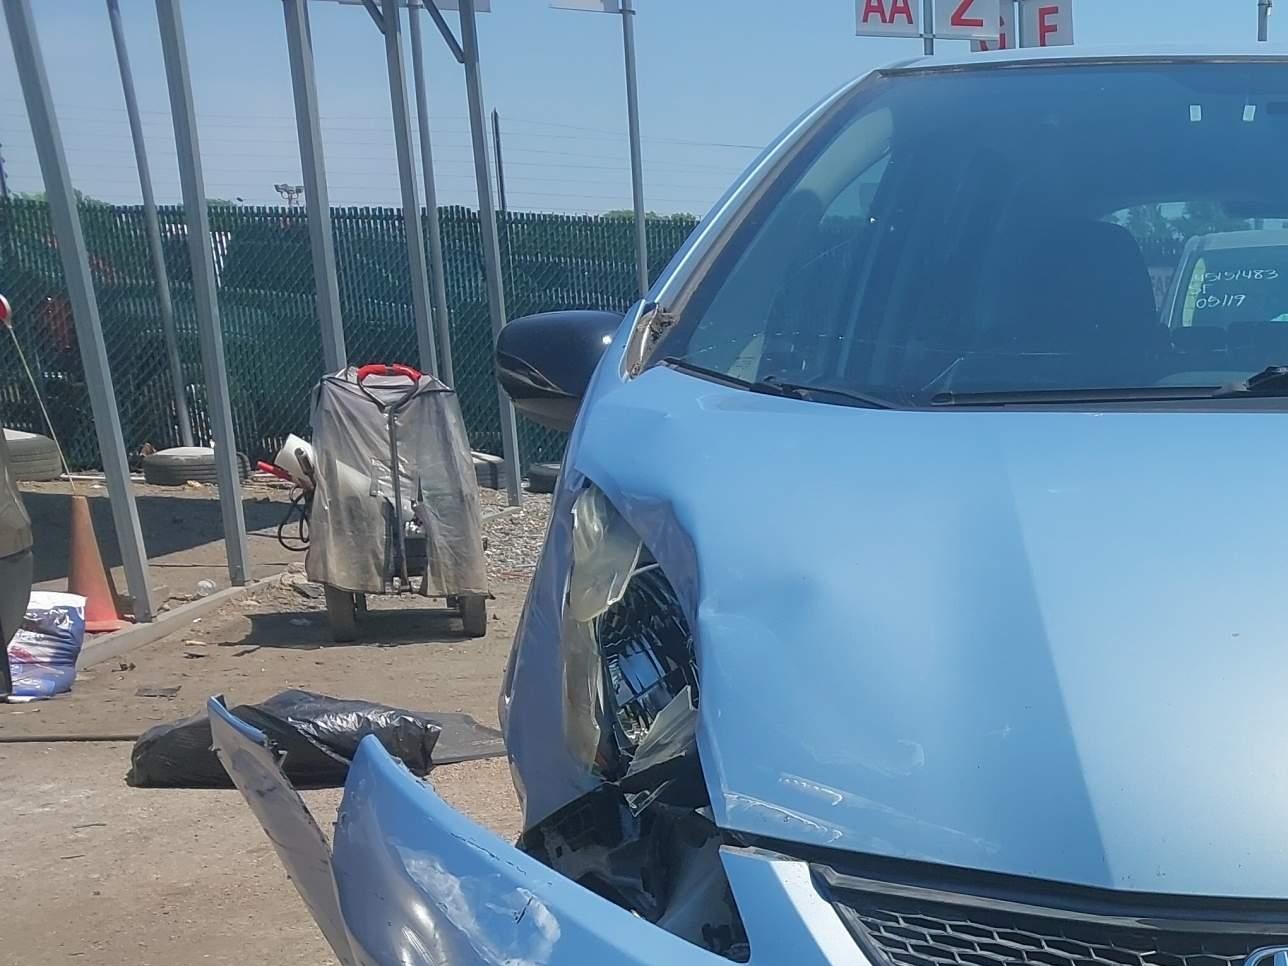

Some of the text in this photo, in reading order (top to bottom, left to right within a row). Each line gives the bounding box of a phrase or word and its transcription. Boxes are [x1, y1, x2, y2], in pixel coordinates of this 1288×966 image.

[861, 0, 914, 25] AA
[950, 0, 984, 27] Z
[1038, 6, 1059, 47] F
